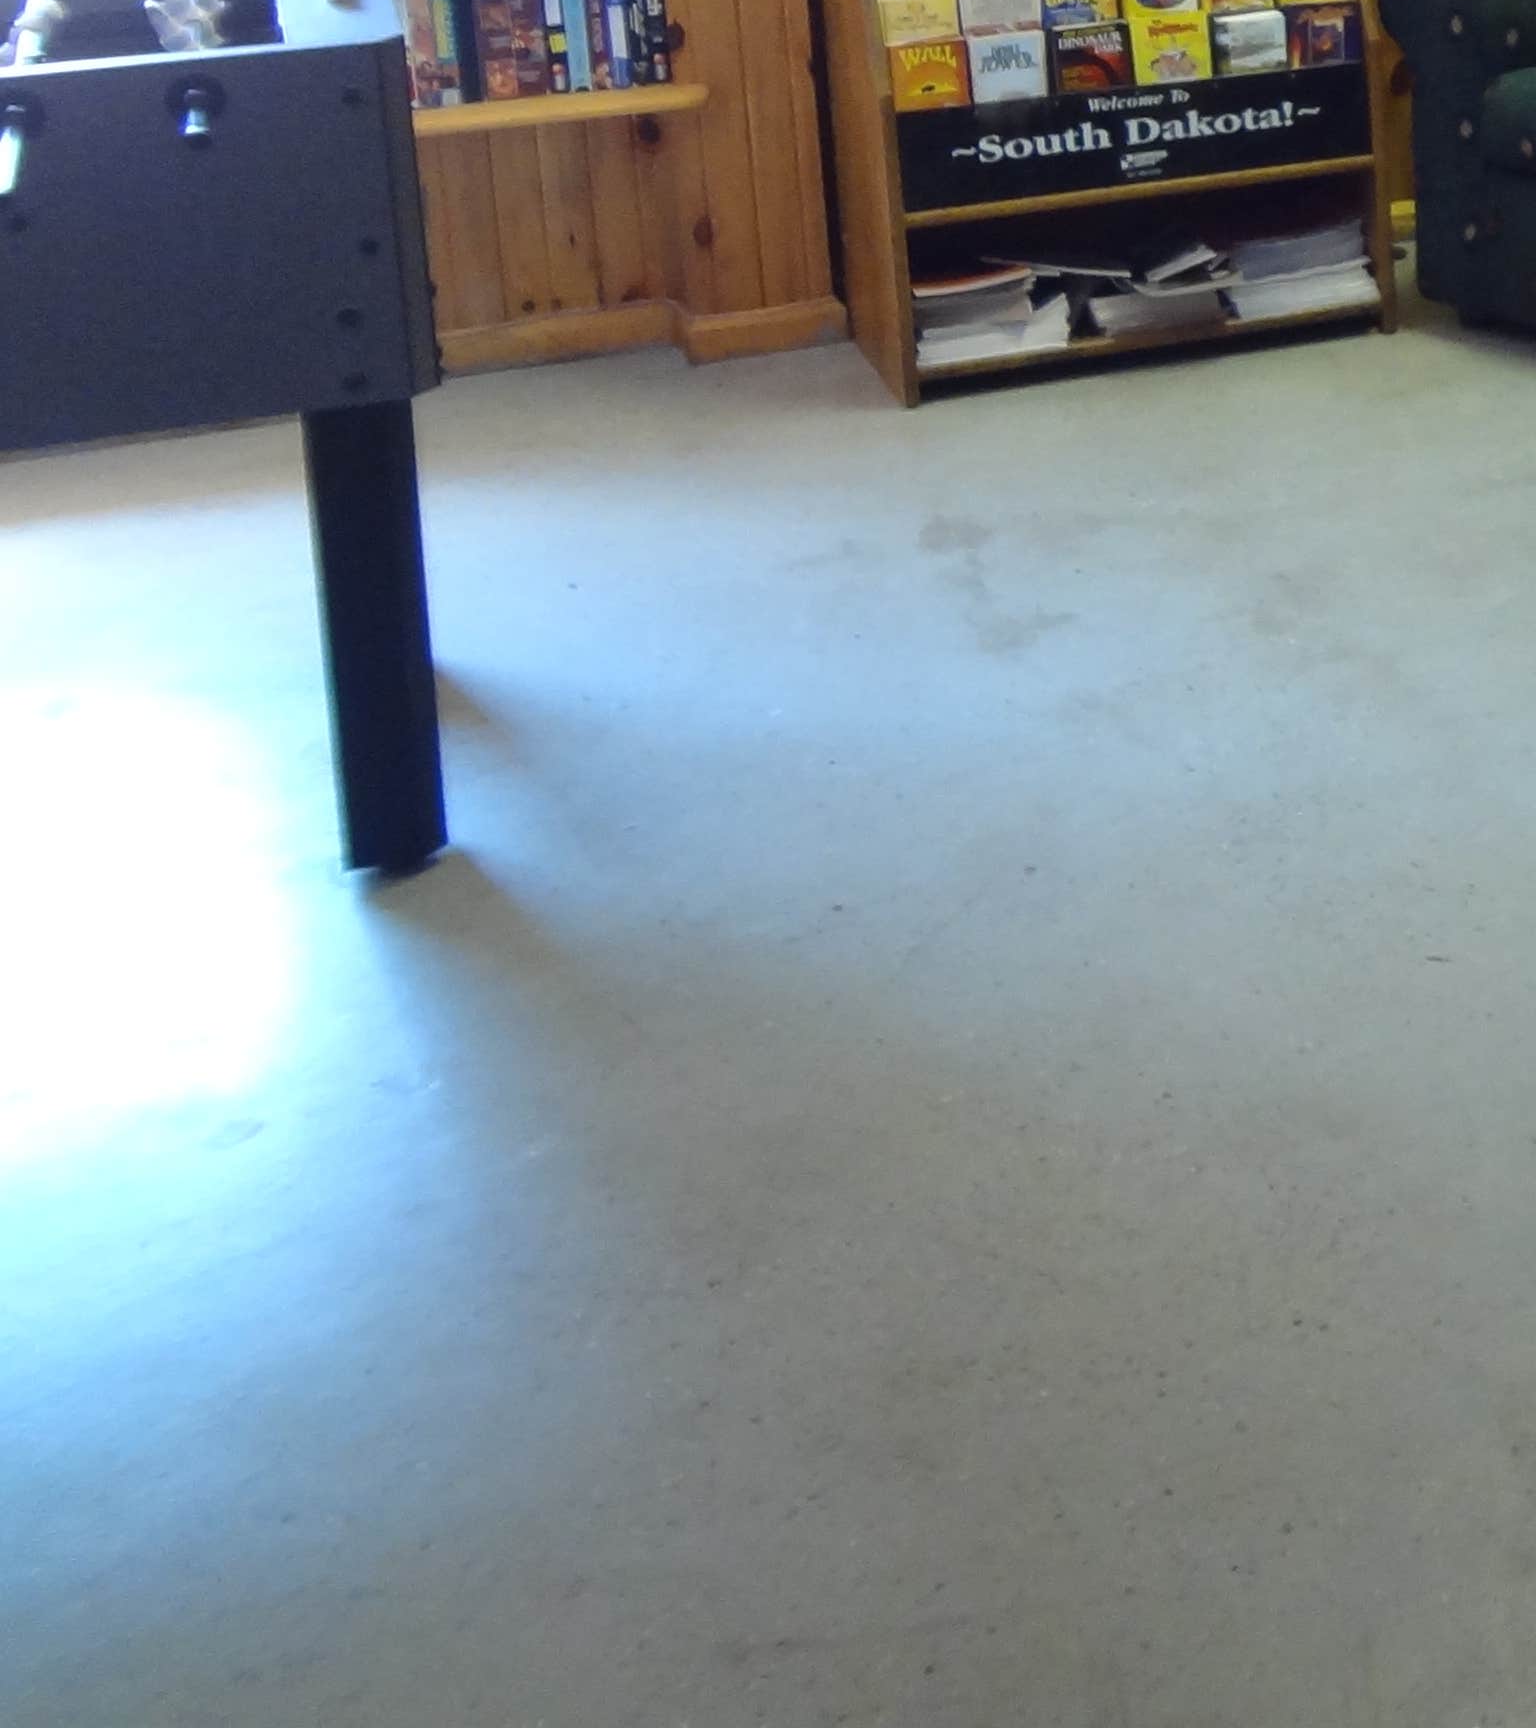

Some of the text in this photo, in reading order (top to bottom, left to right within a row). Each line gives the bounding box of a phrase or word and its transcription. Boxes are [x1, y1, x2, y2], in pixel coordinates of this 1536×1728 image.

[899, 45, 957, 71] WALL
[1088, 89, 1190, 113] Welcome To
